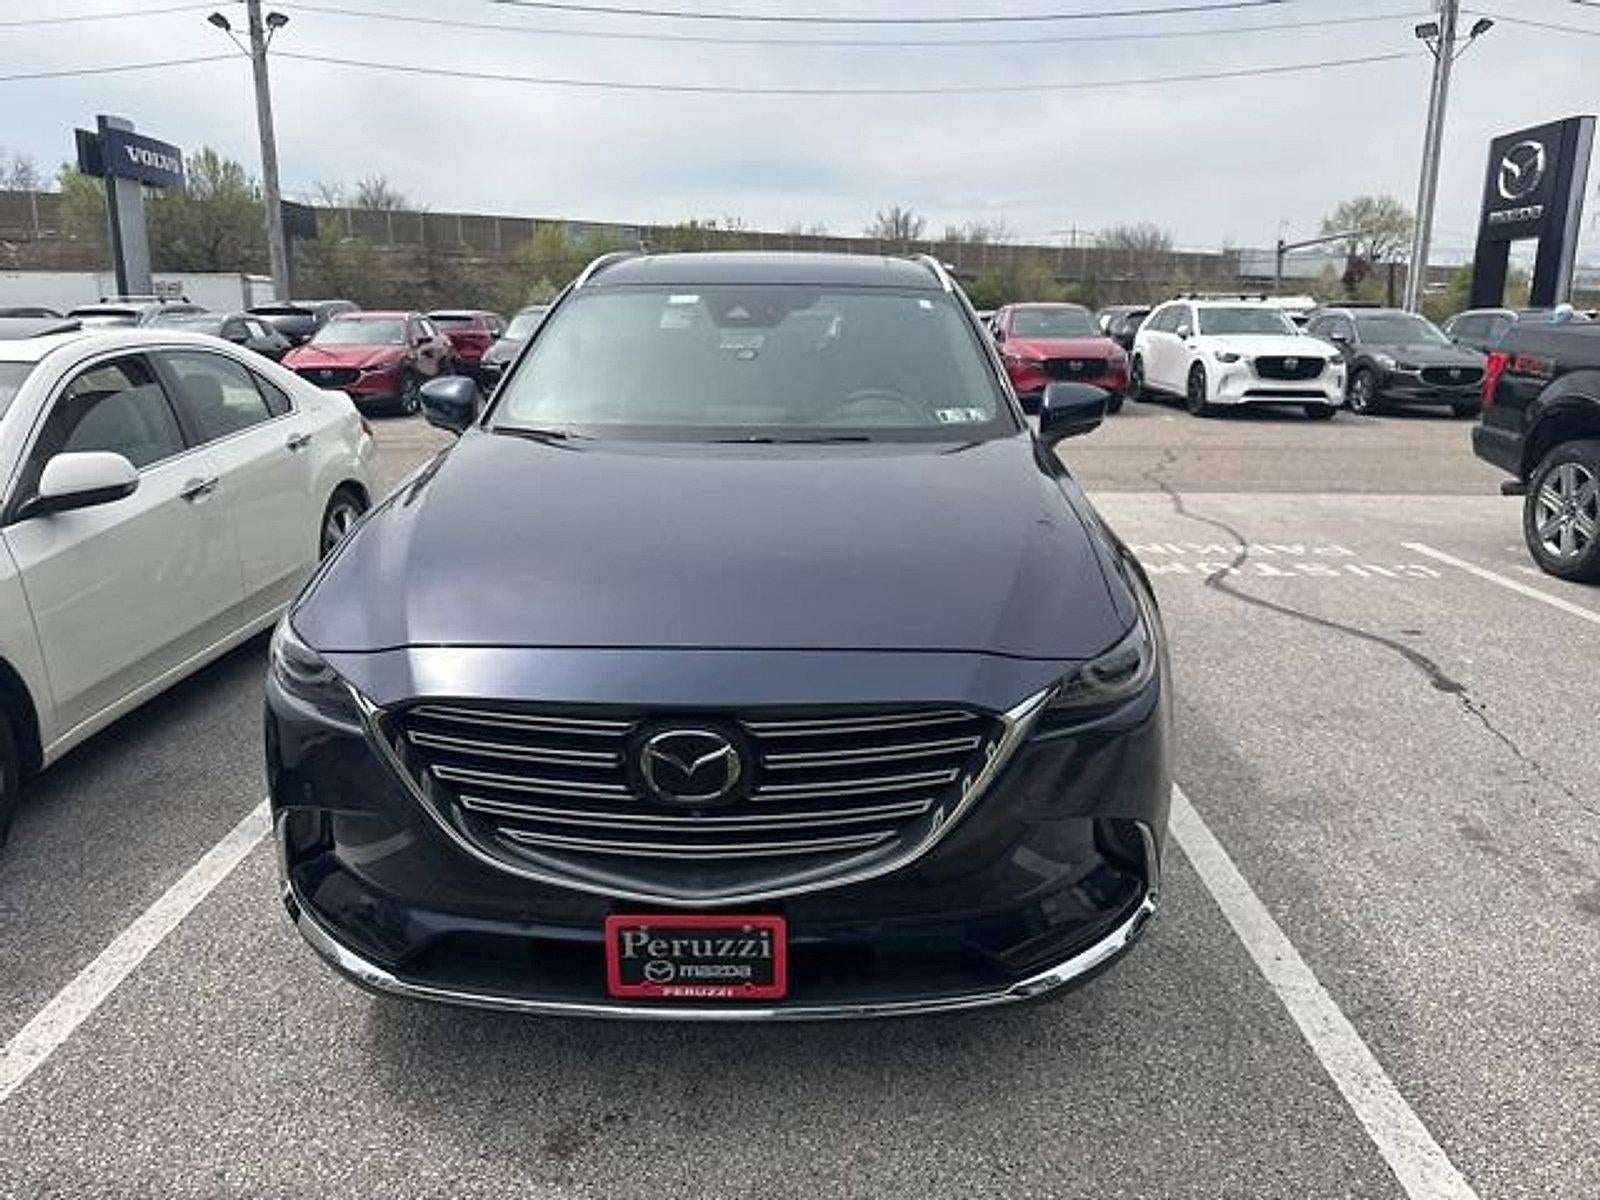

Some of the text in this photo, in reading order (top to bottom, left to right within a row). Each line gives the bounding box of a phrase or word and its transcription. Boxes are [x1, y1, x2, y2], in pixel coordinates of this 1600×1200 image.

[124, 145, 180, 174] VOLVO
[621, 929, 773, 959] Peruzzi
[661, 985, 735, 997] PERUZZI
